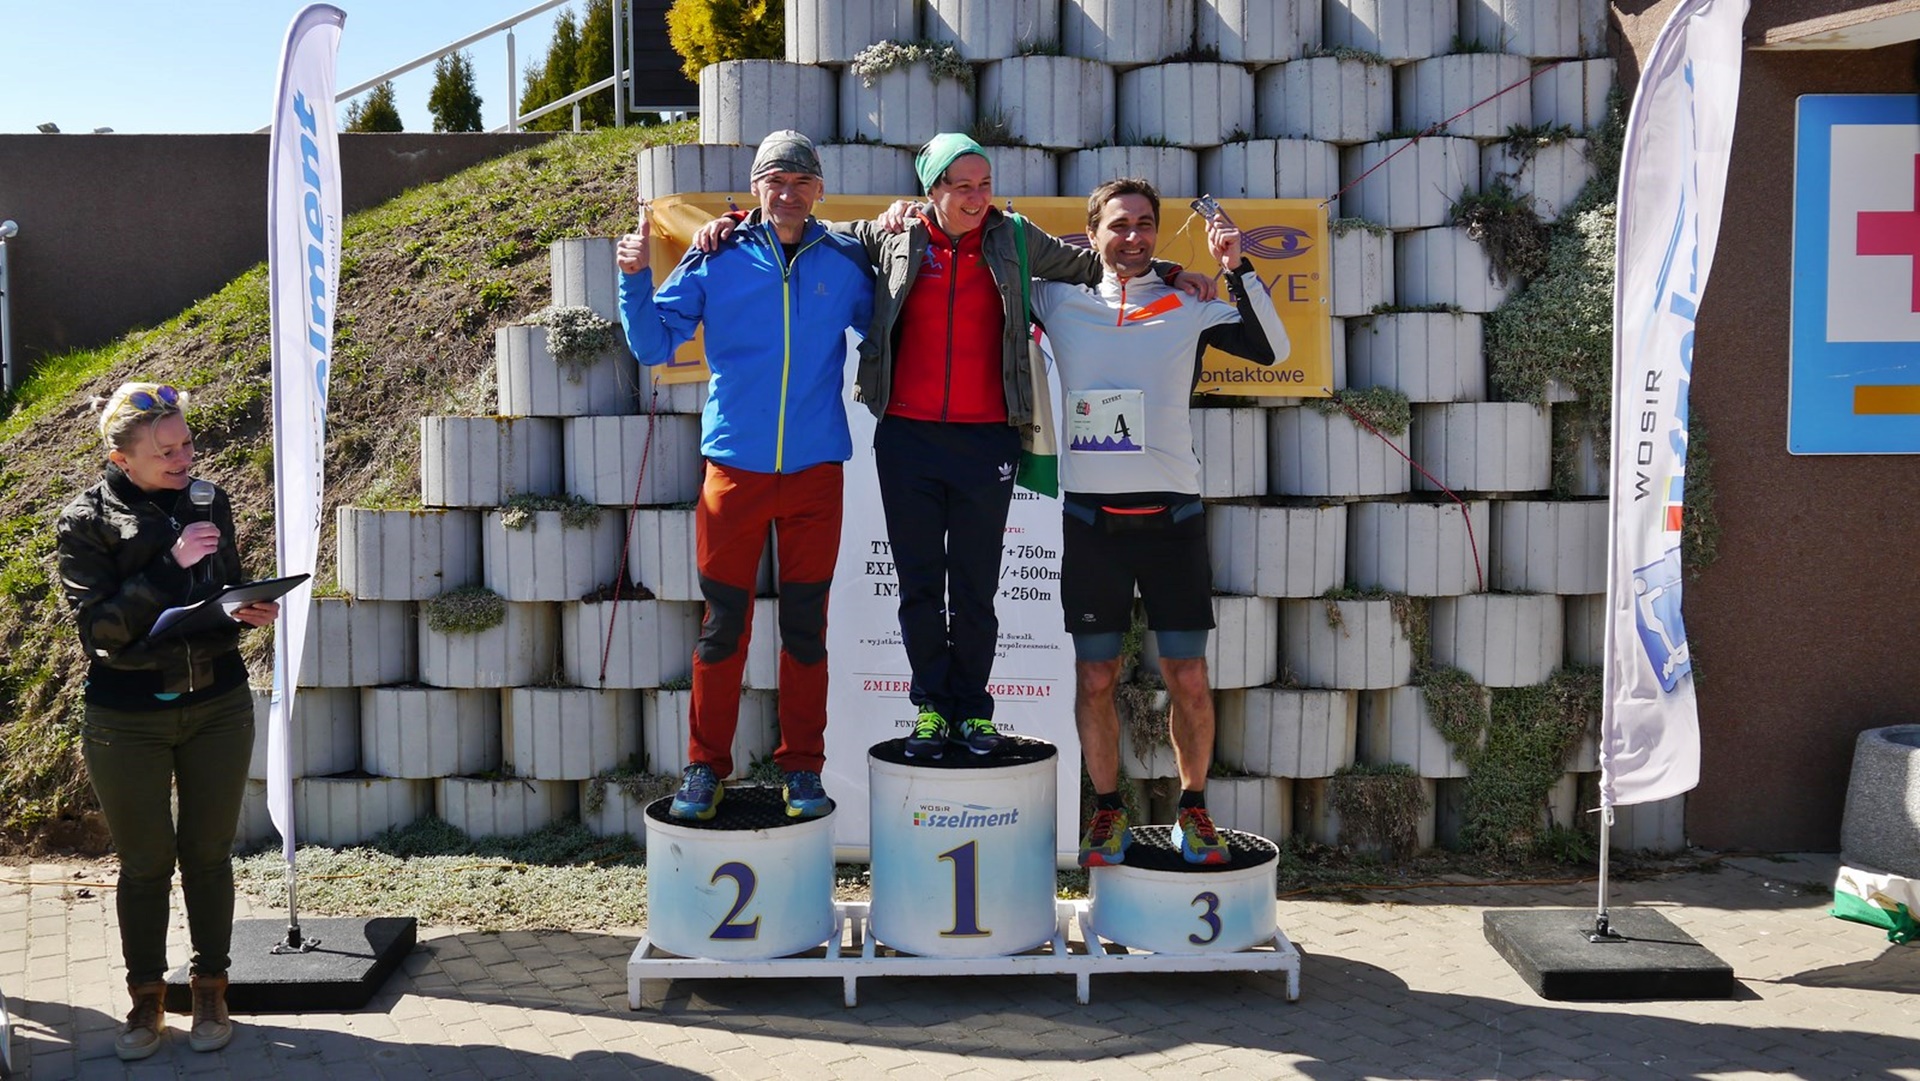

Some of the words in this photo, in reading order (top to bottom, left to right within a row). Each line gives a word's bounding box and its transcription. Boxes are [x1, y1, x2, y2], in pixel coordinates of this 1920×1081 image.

[1200, 366, 1305, 383] ontaktowe
[1113, 413, 1132, 439] 4
[871, 541, 890, 555] TY
[865, 561, 895, 576] EXP
[1001, 565, 1061, 580] /+500m
[874, 582, 898, 597] INT
[1000, 586, 1051, 601] +250m
[864, 680, 910, 692] ZMIER
[988, 685, 1051, 697] EGENDA!
[994, 723, 1015, 731] LTRA
[928, 808, 1019, 827] szelment
[937, 839, 993, 938] 1
[709, 861, 761, 941] 2
[1188, 891, 1222, 946] 3
